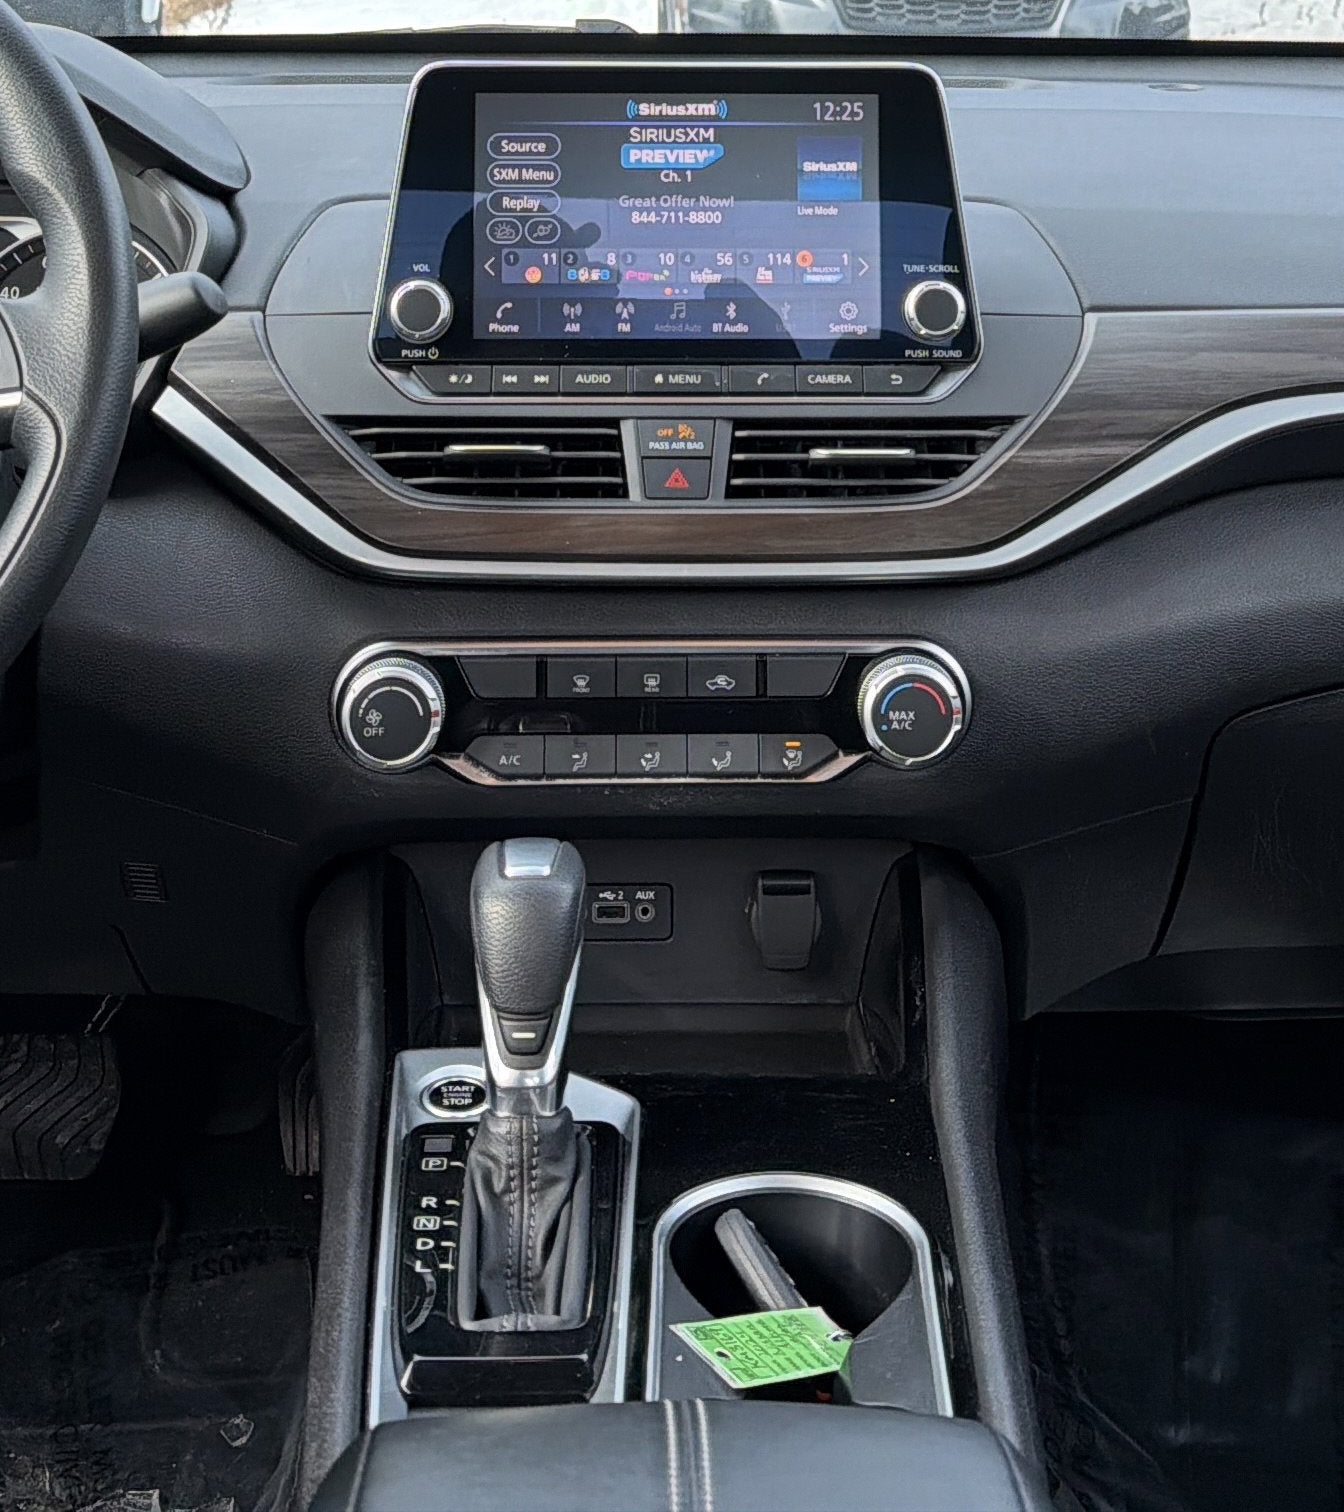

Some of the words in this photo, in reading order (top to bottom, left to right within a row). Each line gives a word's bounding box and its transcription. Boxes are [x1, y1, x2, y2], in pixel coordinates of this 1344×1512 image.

[813, 101, 864, 121] 12:25
[629, 127, 714, 143] SIRIUSXM
[500, 140, 547, 153] Source
[629, 149, 716, 164] PREVIEW
[493, 168, 519, 180] SXM
[522, 168, 555, 181] Menu
[660, 170, 682, 182] Ch.
[685, 170, 693, 182] 1
[502, 196, 541, 212] Replay
[618, 195, 657, 207] Great
[659, 195, 696, 207] Offer
[699, 195, 735, 207] Now!
[797, 206, 813, 215] Live
[814, 206, 839, 215] Mode
[631, 211, 722, 224] 844-711-8800
[542, 252, 557, 265] 11
[607, 252, 617, 265] 8
[659, 252, 675, 265] 10
[716, 252, 733, 265] 56
[767, 252, 792, 265] 114
[841, 253, 849, 265] 1
[412, 263, 431, 272] VOL
[0, 286, 20, 299] 40
[488, 323, 520, 333] Phone
[564, 323, 581, 333] AM
[617, 323, 631, 333] FM
[712, 323, 722, 333] BT
[723, 323, 749, 333] Audio
[828, 323, 868, 335] Settings
[401, 349, 426, 358] PUSH
[905, 350, 929, 358] PUSH
[932, 350, 963, 358] SOUND
[575, 374, 612, 384] AUDIO
[668, 374, 702, 384] MENU
[807, 374, 852, 384] CAMERA
[657, 428, 674, 437] OFF
[648, 441, 669, 450] PASS
[671, 441, 685, 450] AIR
[686, 441, 704, 450] BAG
[889, 711, 916, 721] MAX
[890, 720, 913, 731] A/C
[363, 727, 386, 737] OFF
[498, 755, 522, 766] A/C
[617, 891, 624, 900] 2
[635, 891, 656, 900] AUX
[440, 1085, 477, 1093] START
[442, 1098, 473, 1106] STOP
[421, 1196, 438, 1208] R
[419, 1218, 435, 1228] N
[416, 1237, 435, 1250] D
[414, 1260, 432, 1273] L
